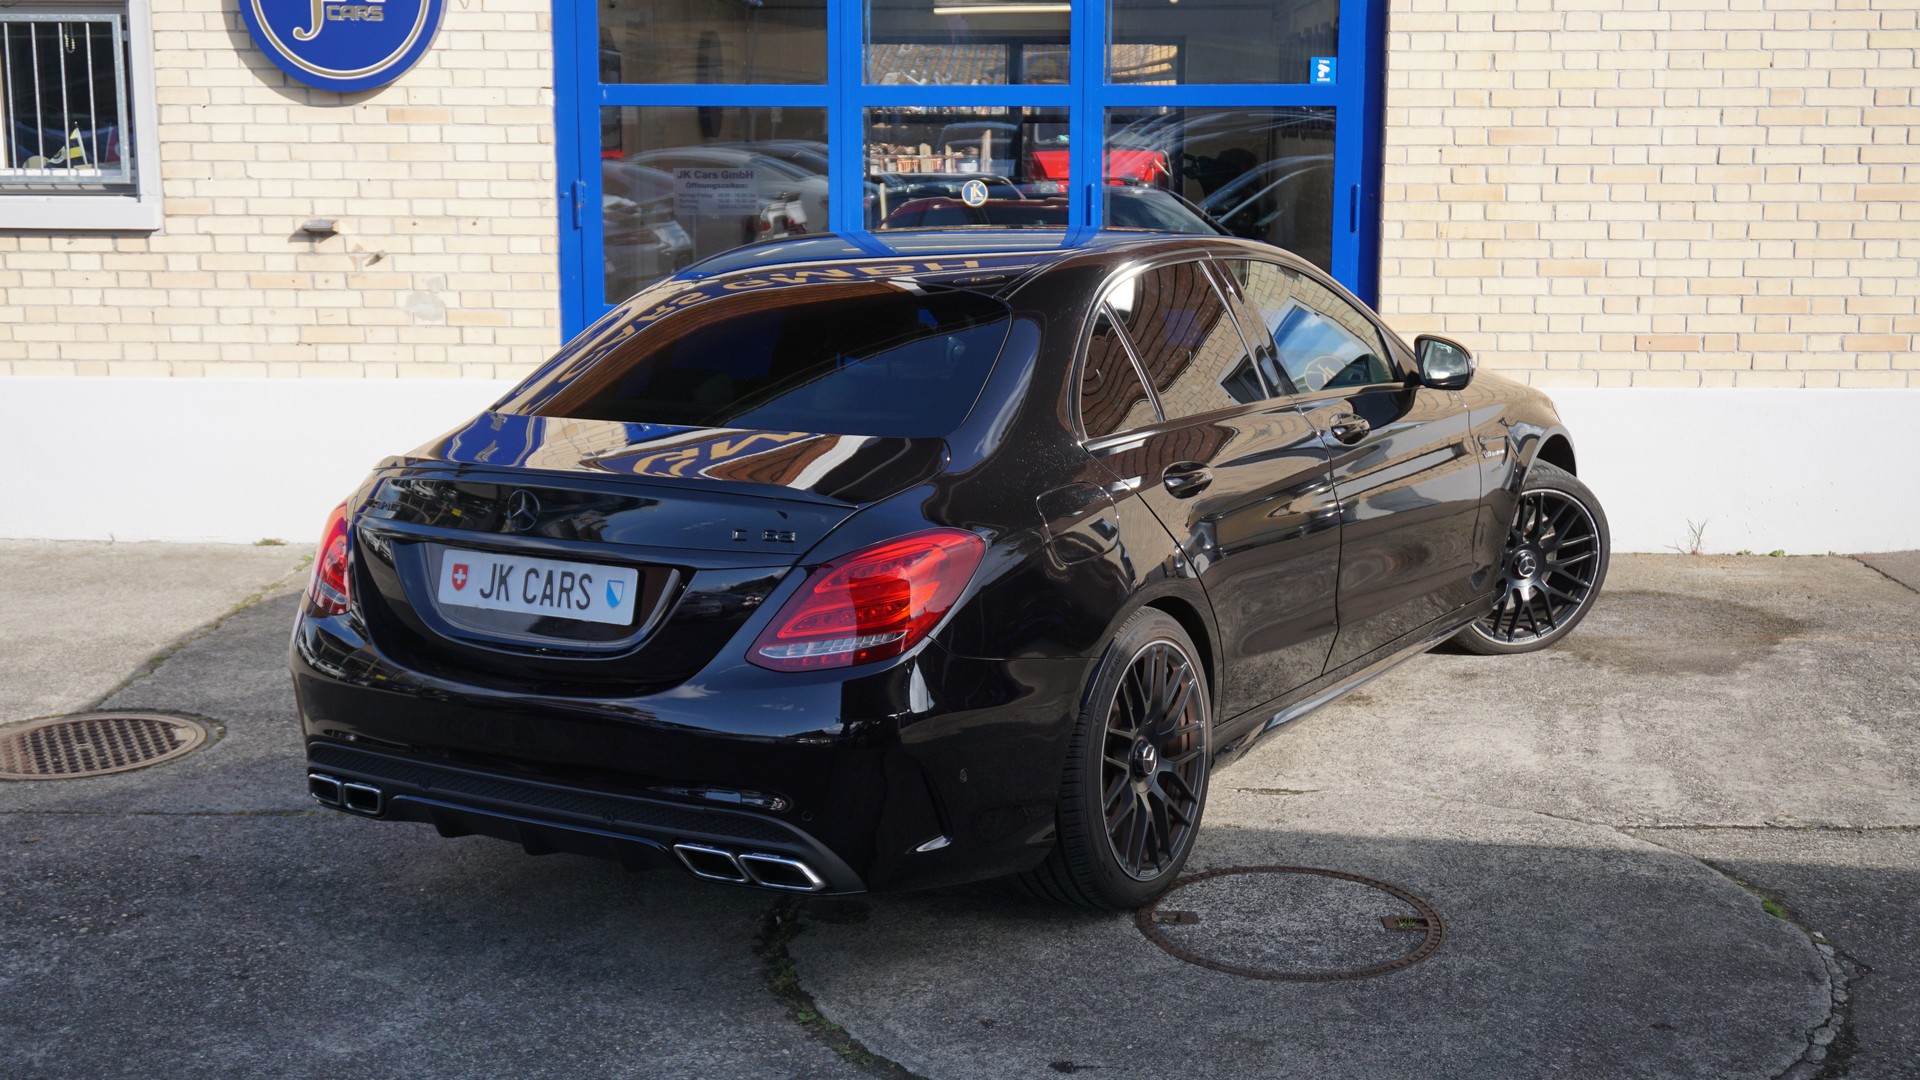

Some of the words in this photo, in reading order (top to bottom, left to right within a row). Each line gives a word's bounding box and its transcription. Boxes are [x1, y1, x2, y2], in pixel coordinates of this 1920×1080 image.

[326, 5, 384, 21] CARS
[677, 170, 691, 179] JK
[694, 170, 718, 179] Cars
[721, 170, 754, 179] GmbH
[732, 529, 748, 541] C
[762, 529, 796, 543] 63
[479, 563, 514, 602] JK
[522, 567, 593, 610] CARS
